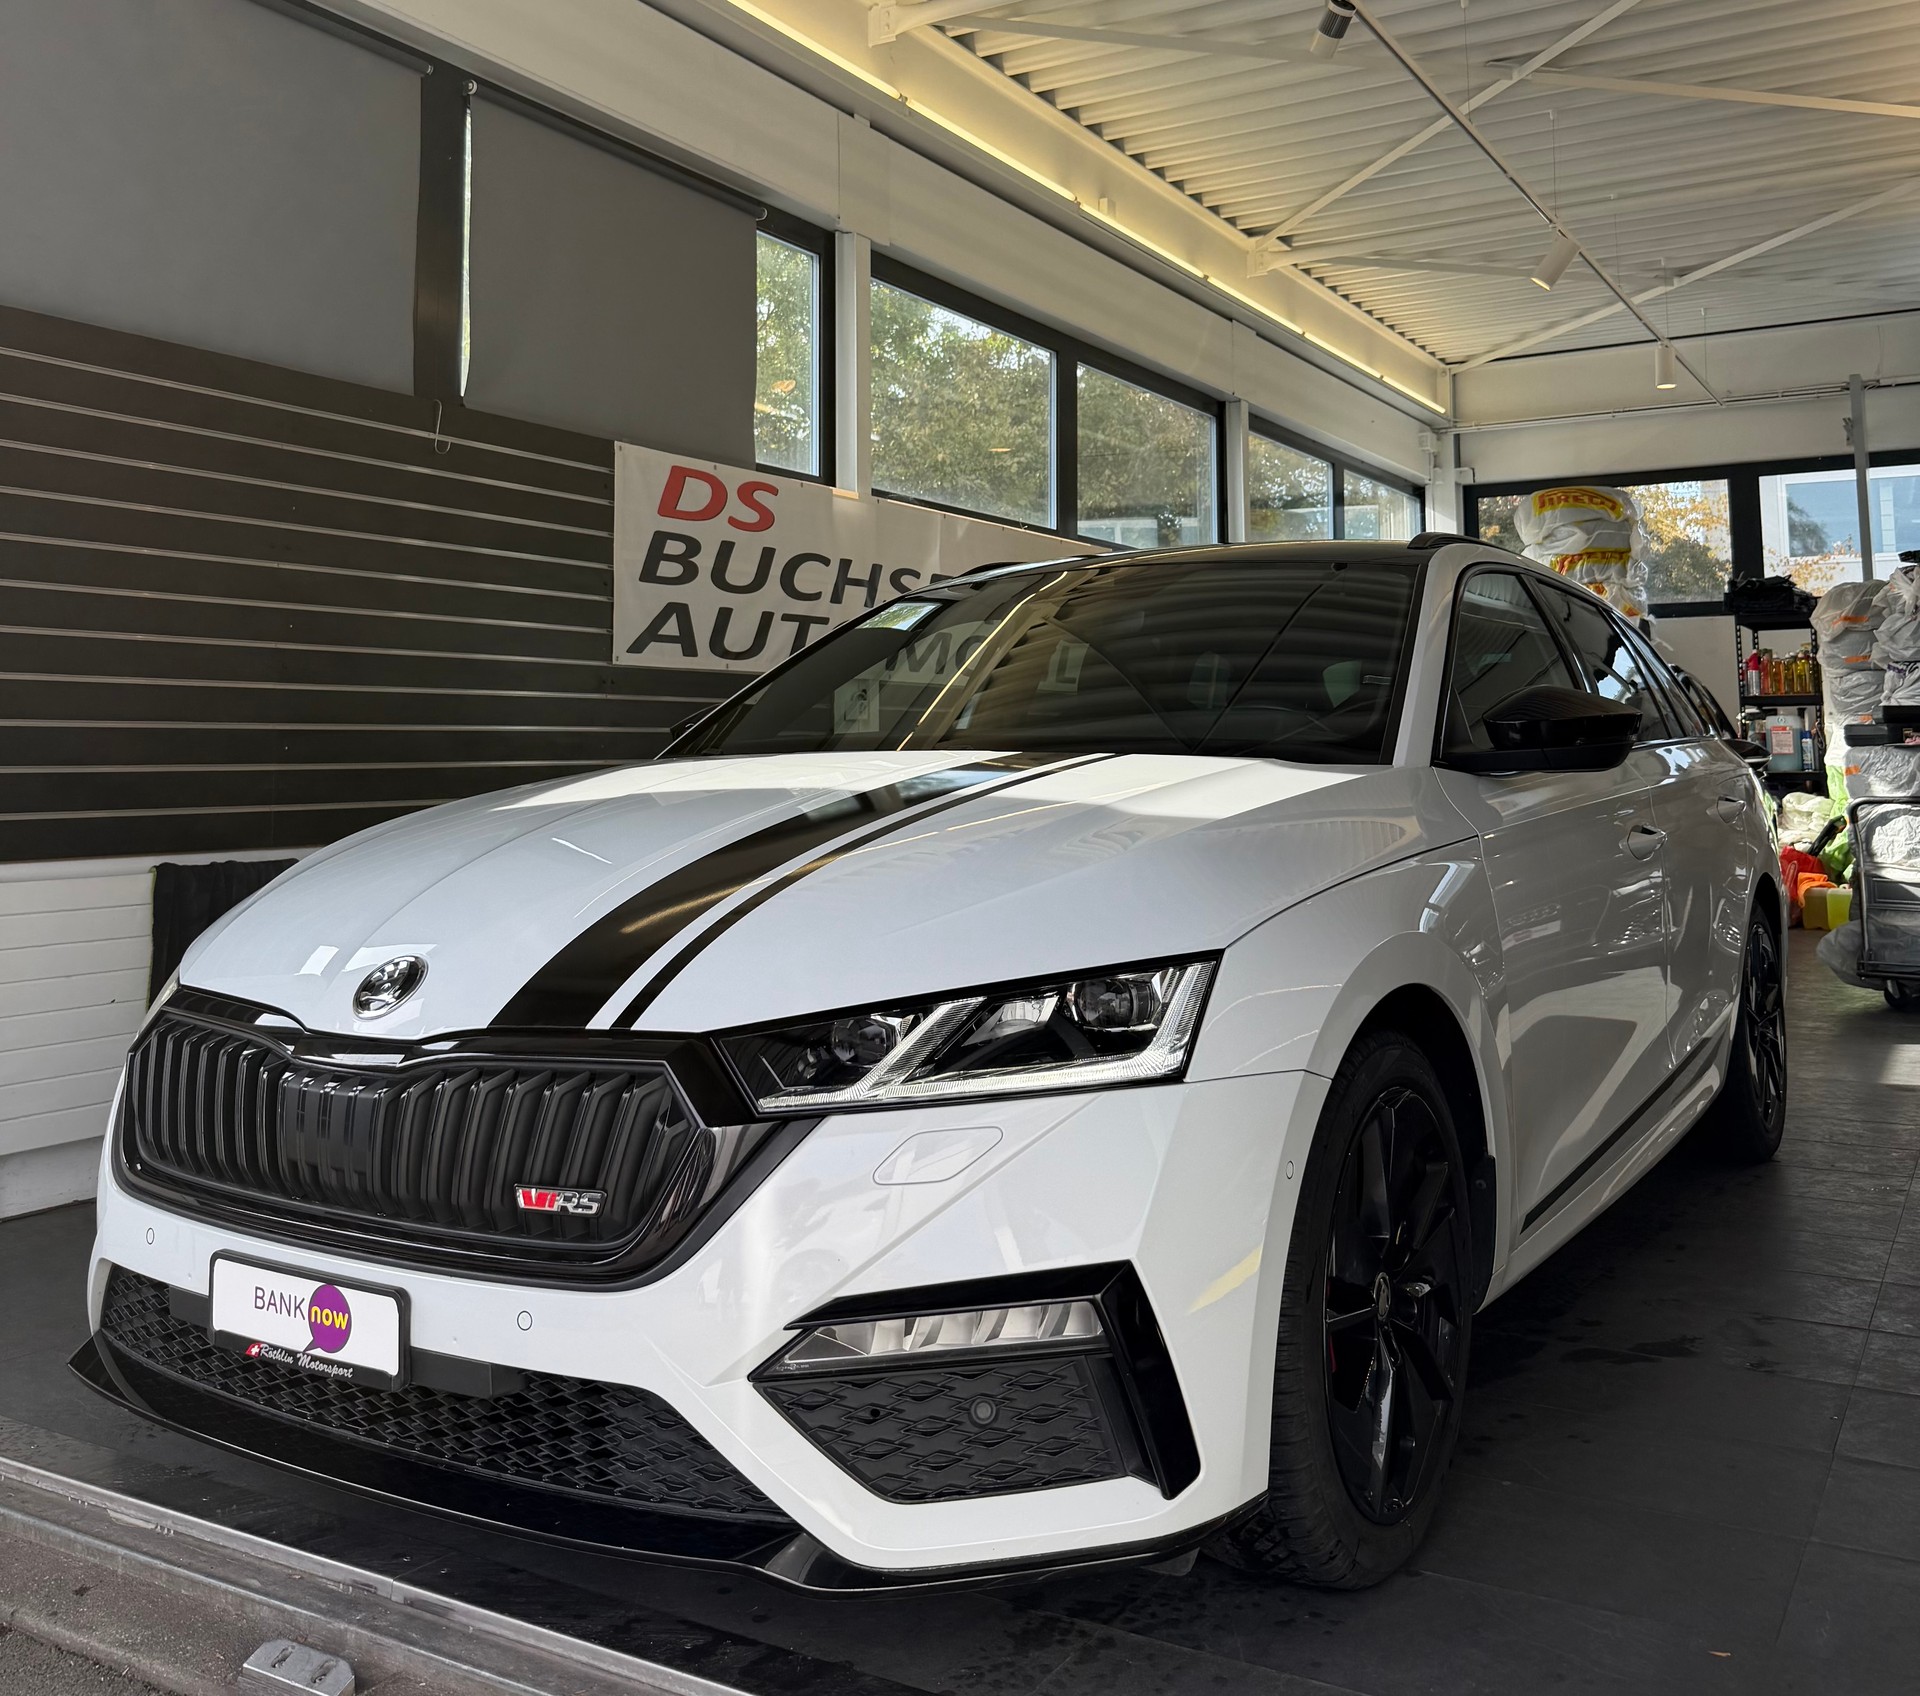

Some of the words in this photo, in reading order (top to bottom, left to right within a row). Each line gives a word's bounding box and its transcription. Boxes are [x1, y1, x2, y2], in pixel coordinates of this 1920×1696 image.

[656, 465, 779, 532] DS
[638, 530, 954, 608] BUCHS
[254, 1286, 306, 1321] BANK
[310, 1305, 349, 1331] now
[260, 1343, 294, 1364] Röthlin
[297, 1353, 353, 1378] Motorsport
